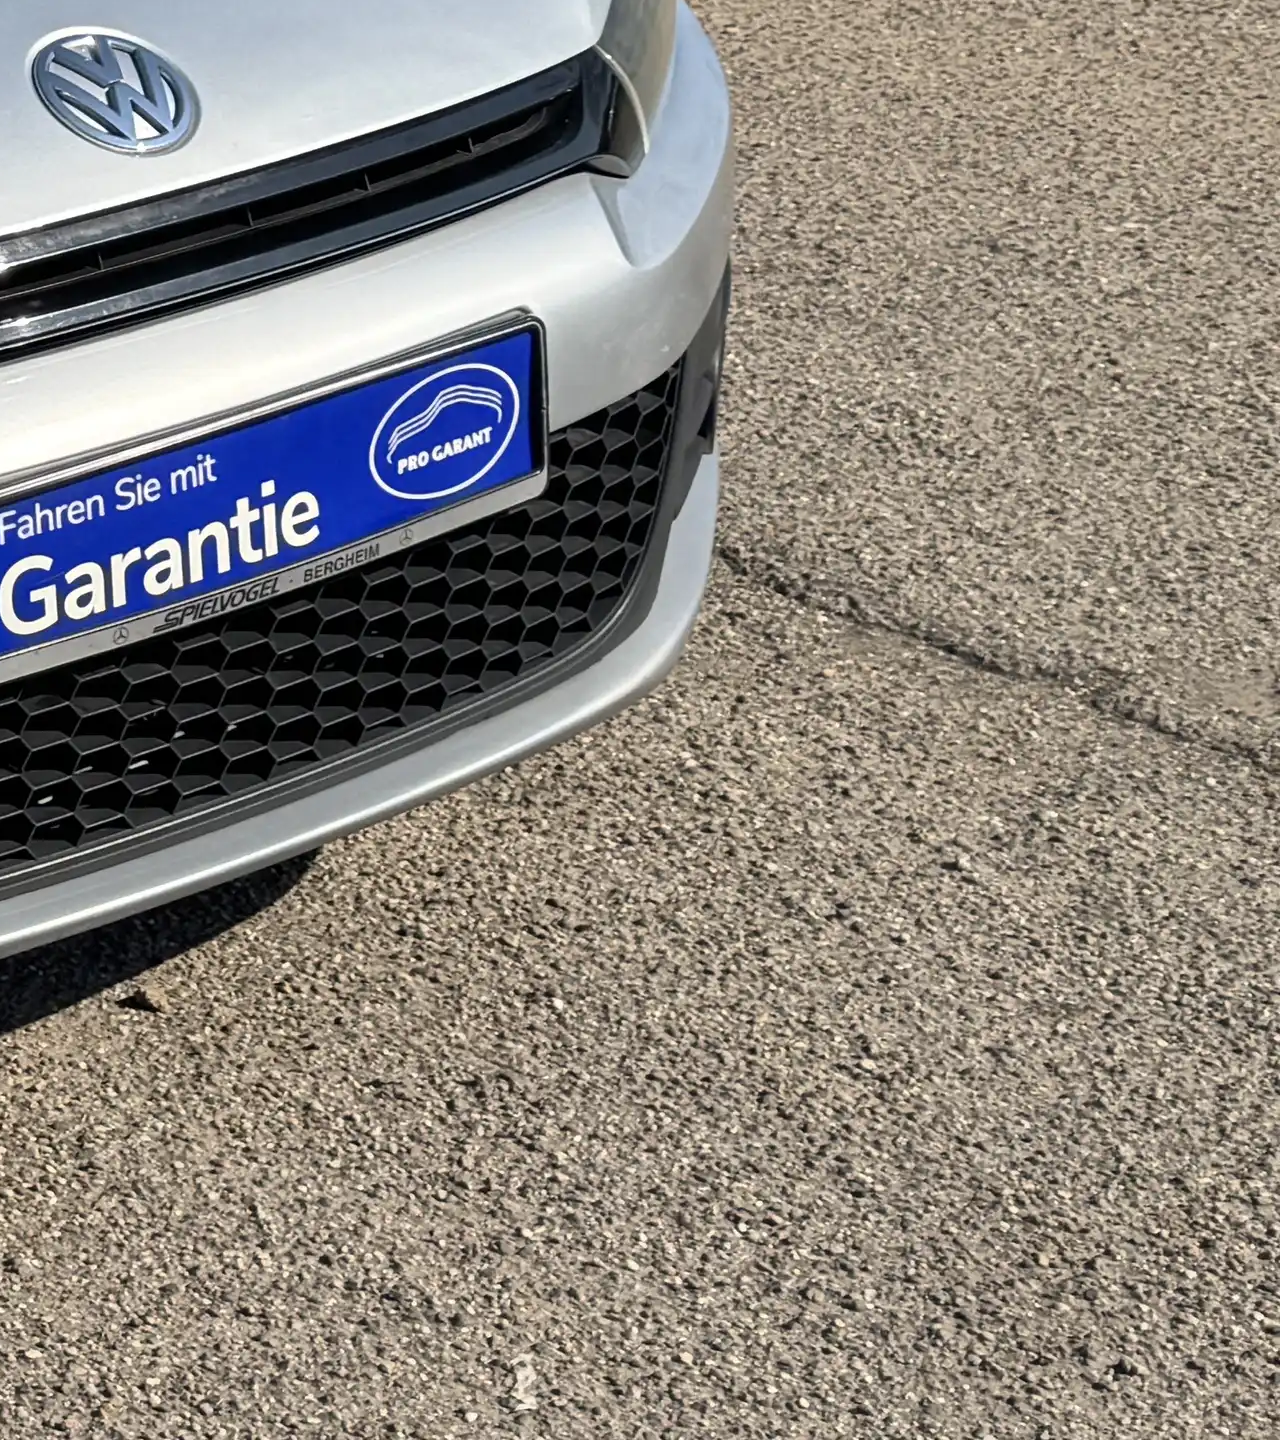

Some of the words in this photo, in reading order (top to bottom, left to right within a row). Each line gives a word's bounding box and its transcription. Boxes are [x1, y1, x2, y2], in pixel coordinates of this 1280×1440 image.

[397, 450, 430, 475] PRO
[431, 426, 493, 461] GARANT
[114, 474, 162, 511] Sie
[169, 453, 218, 495] mit
[153, 577, 280, 633] SPIELVOGEL
[303, 543, 381, 583] BERGHEIM
